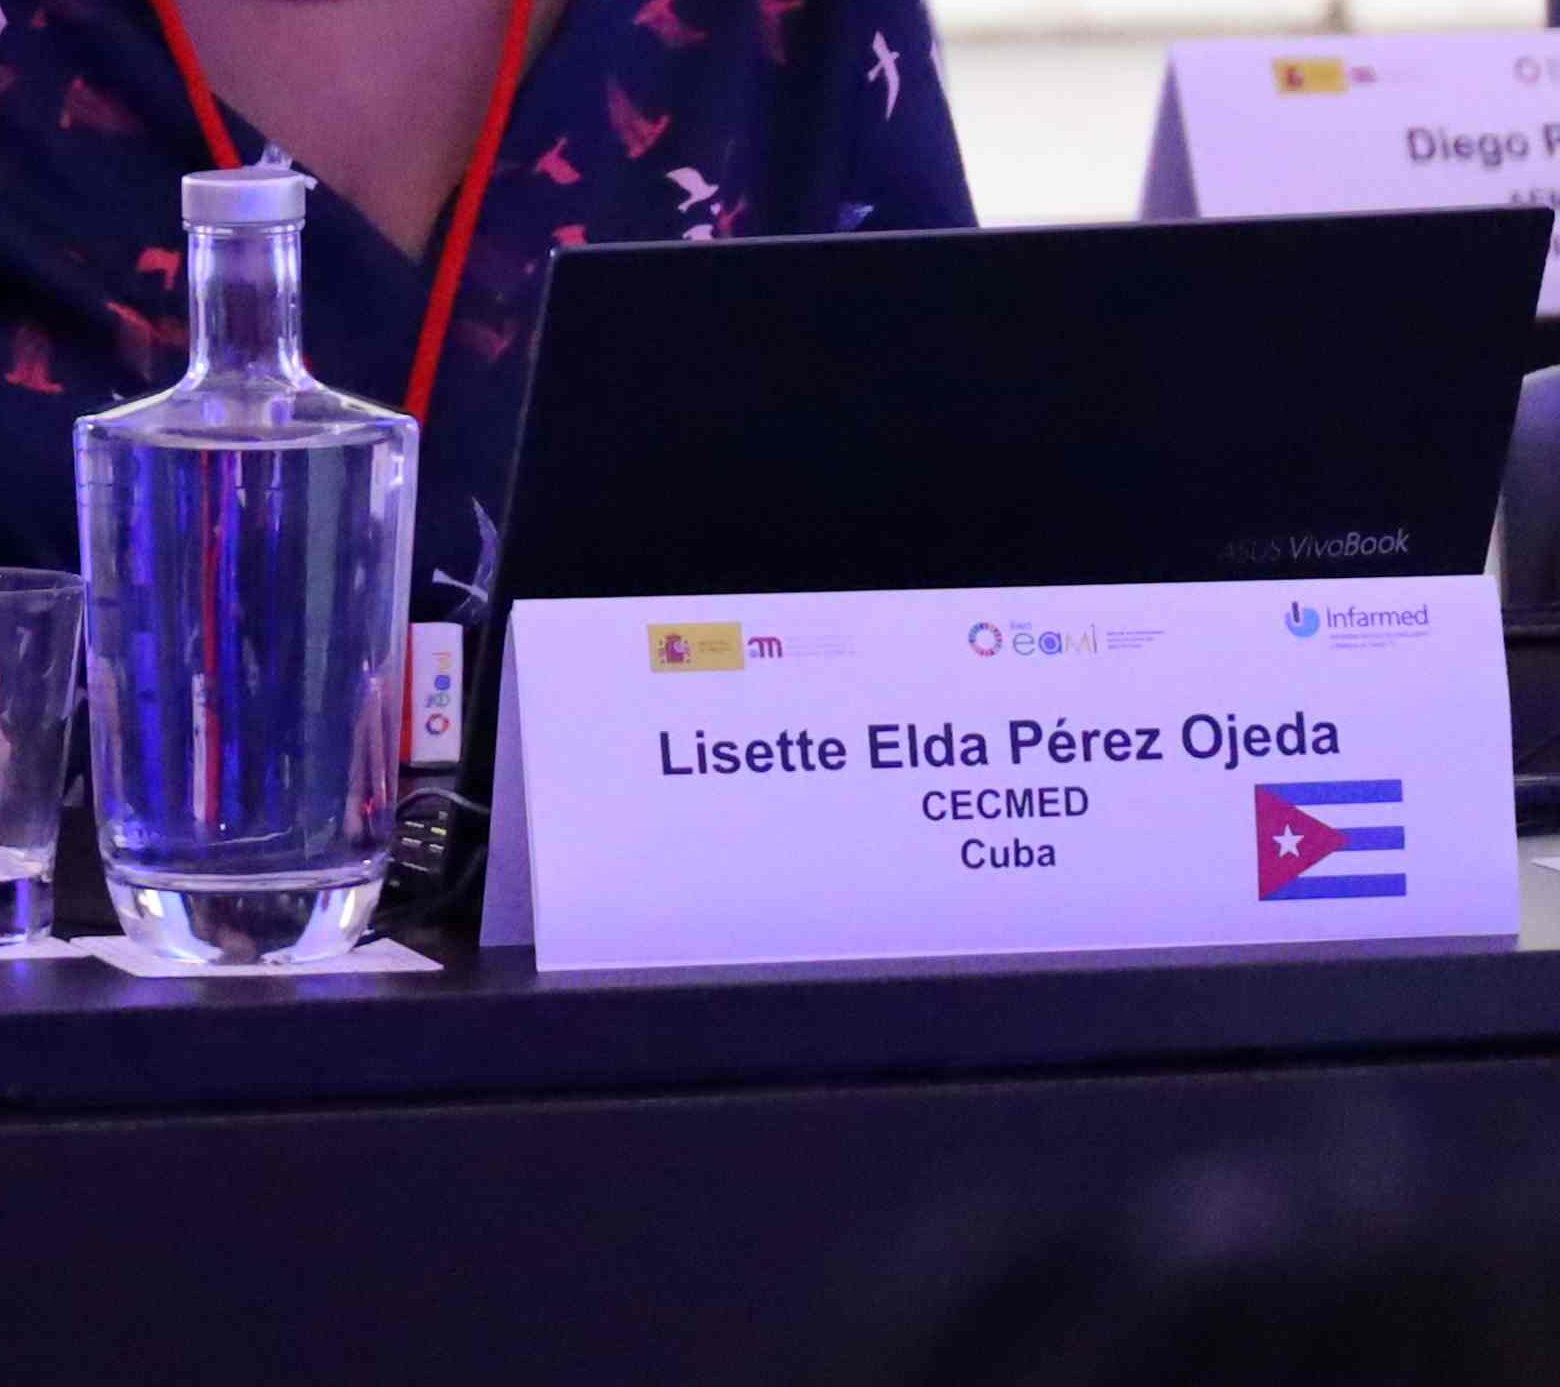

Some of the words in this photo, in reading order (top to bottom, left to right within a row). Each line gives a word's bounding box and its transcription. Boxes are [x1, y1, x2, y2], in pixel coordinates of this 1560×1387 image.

[1404, 125, 1531, 169] Diego
[1288, 527, 1410, 562] VivoBook
[1326, 603, 1430, 628] Infarmed
[659, 729, 847, 776] Lisette
[867, 722, 989, 770] Elda
[1008, 717, 1164, 765] Pérez
[1181, 711, 1340, 767] Ojeda
[922, 786, 1089, 822] CECMED
[960, 837, 1056, 870] Cuba
